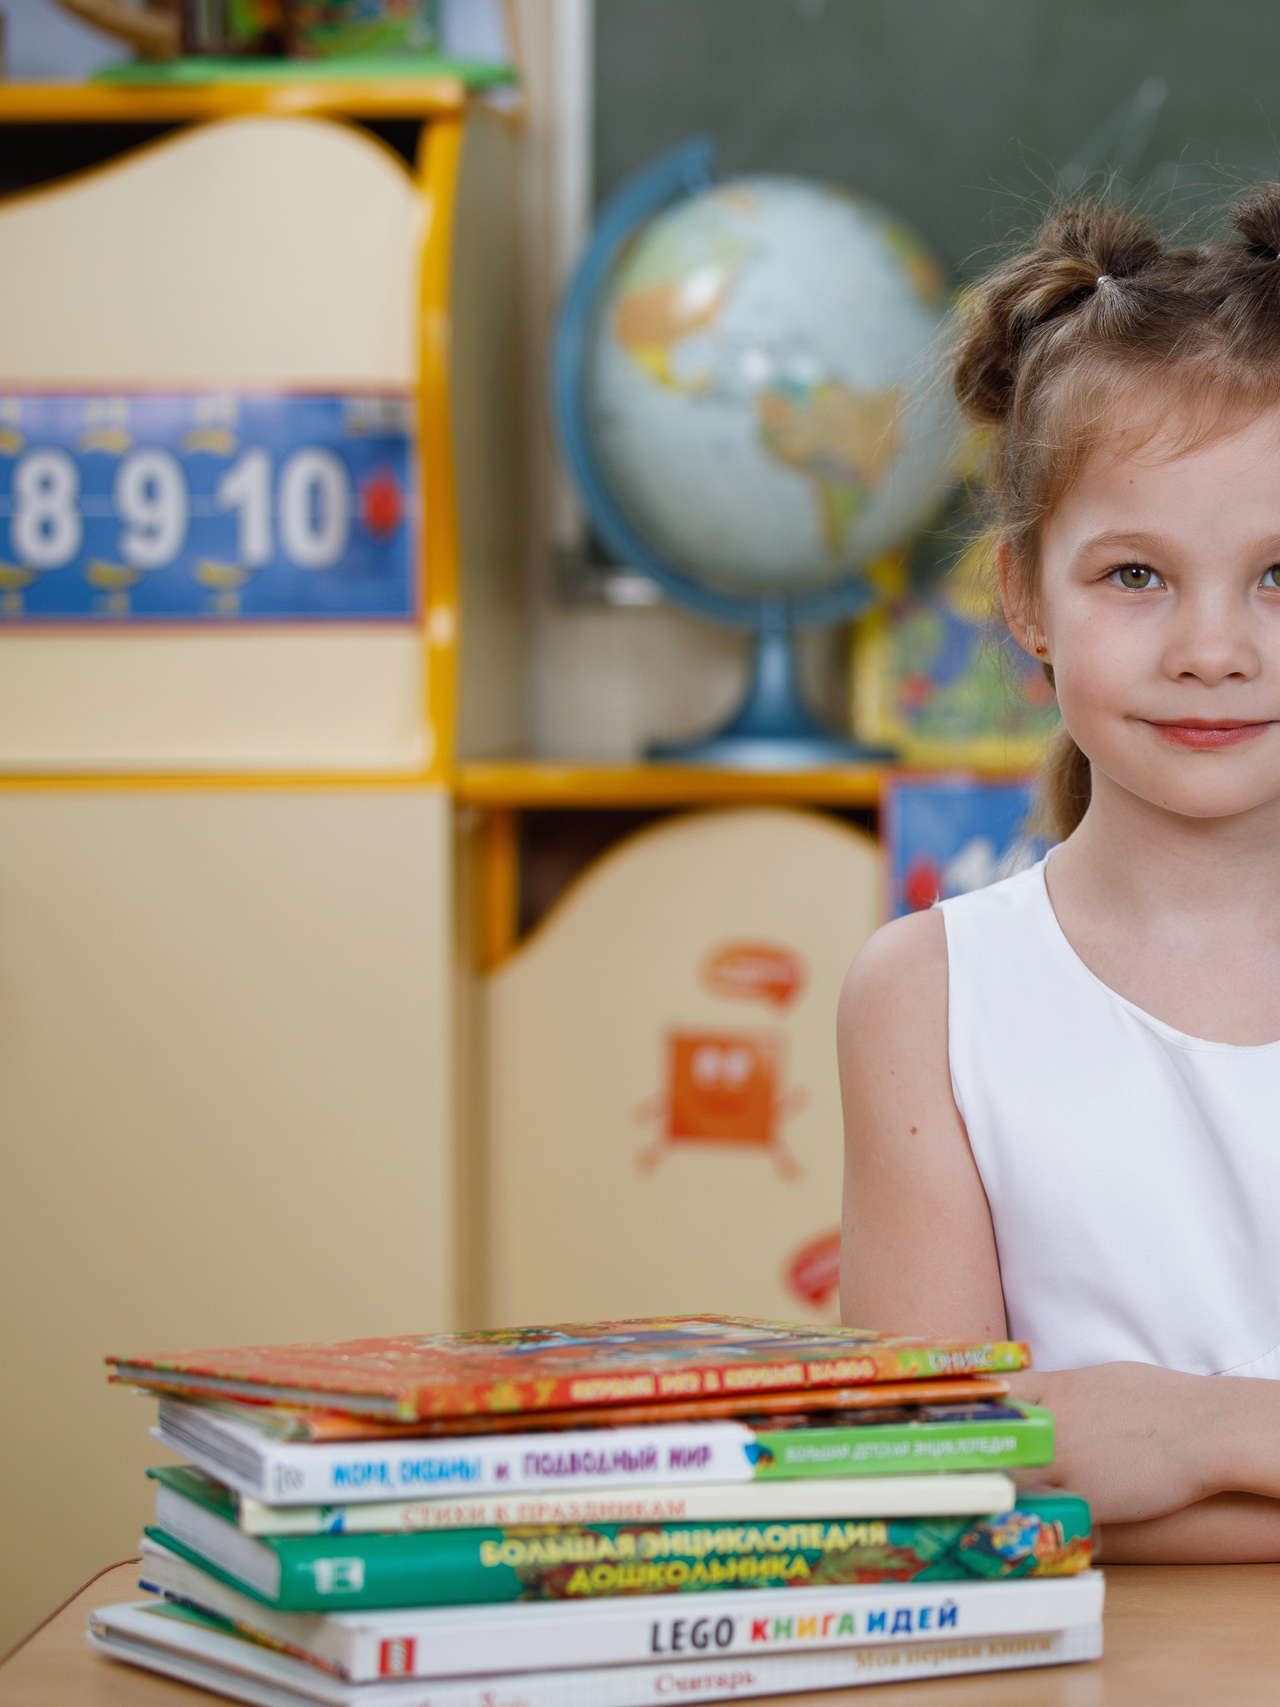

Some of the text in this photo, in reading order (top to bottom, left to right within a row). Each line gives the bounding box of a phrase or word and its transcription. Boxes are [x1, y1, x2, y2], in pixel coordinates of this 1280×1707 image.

[11, 445, 353, 571] 8 9 10
[929, 1344, 997, 1371] ОНИКС
[399, 1456, 482, 1485] ОКЕАНЫ
[524, 1443, 659, 1478] ПОДВОДНЫЙ
[669, 1445, 712, 1470] МИР
[403, 1499, 687, 1529] СТИХИ К ПРАЗДНИКАМ
[480, 1520, 887, 1567] БОЛЬШАЯ ЭНЦИКЛОПЕДИЯ
[566, 1553, 812, 1596] ДОШКОЛЬНИКА
[651, 1598, 959, 1653] LEGO КНИГА ИДЕЙ
[855, 1635, 1051, 1669] Моя первая книга
